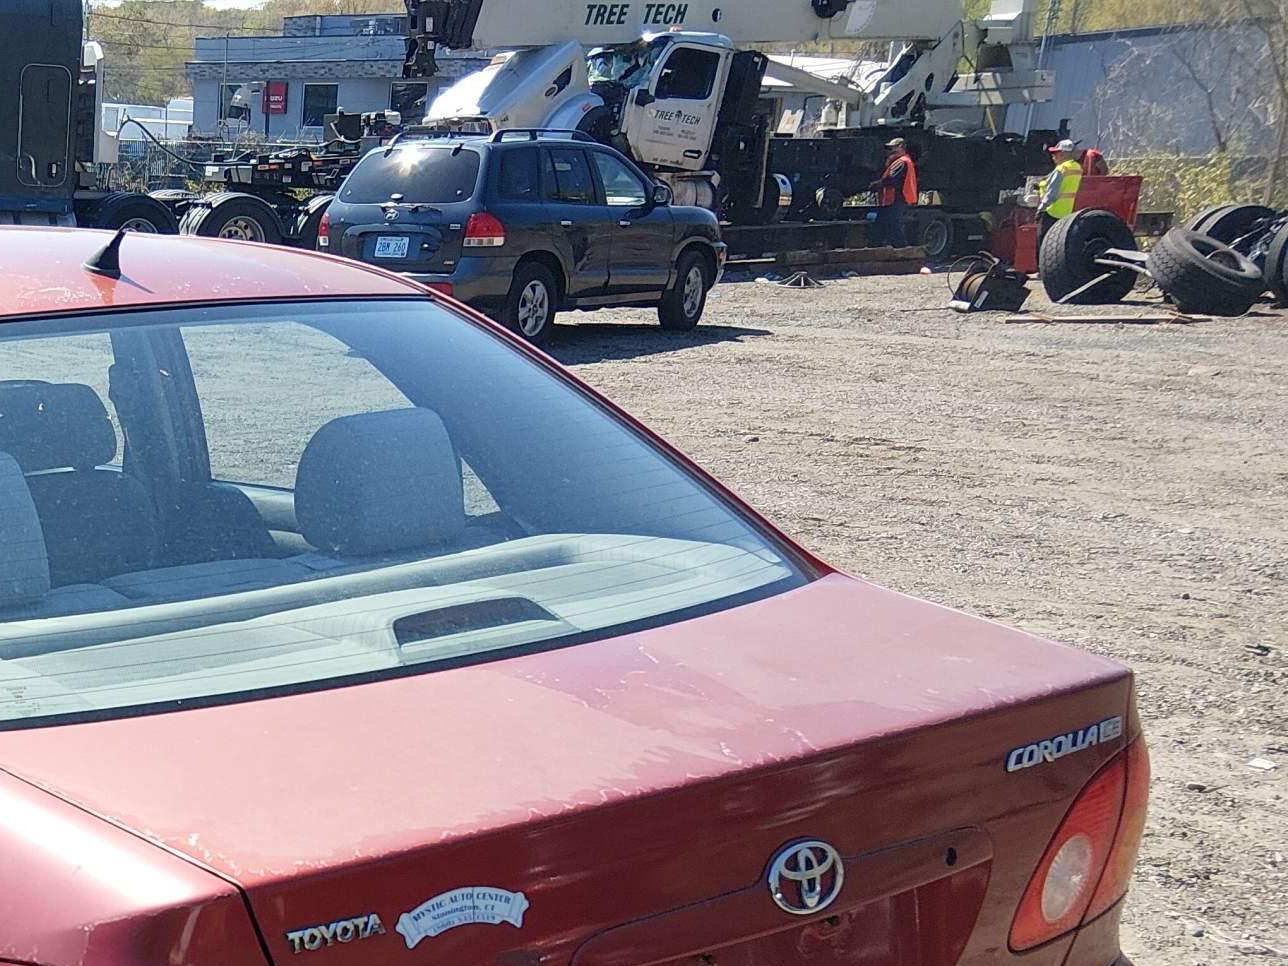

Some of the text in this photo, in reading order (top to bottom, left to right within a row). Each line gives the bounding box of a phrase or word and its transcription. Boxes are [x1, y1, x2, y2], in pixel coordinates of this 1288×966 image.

[584, 3, 688, 25] TREE TECH
[654, 109, 701, 125] TREE TECH
[1007, 724, 1098, 772] COROLLA
[412, 892, 512, 922] MYSTIC AUTO CENTER
[286, 913, 387, 955] TOYOTA
